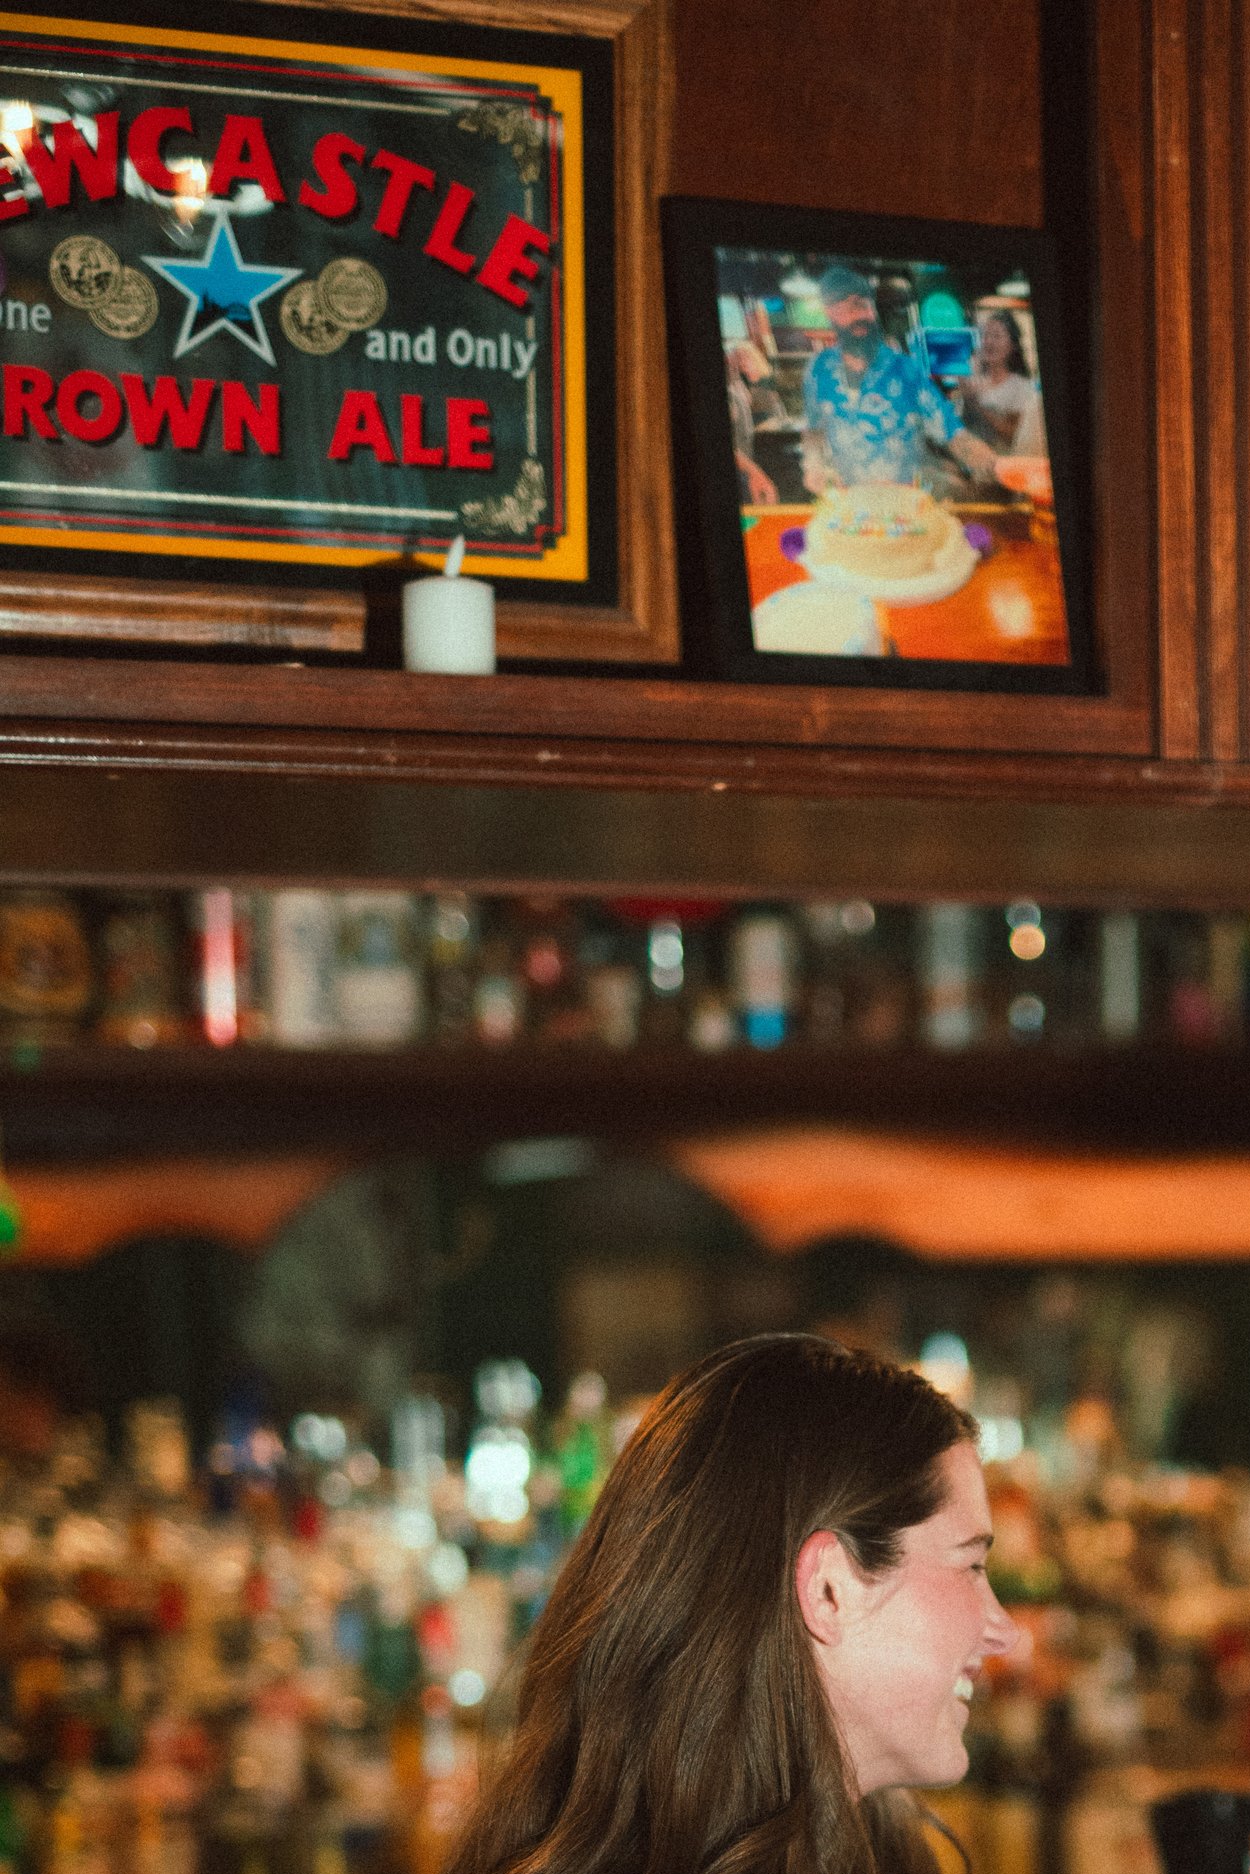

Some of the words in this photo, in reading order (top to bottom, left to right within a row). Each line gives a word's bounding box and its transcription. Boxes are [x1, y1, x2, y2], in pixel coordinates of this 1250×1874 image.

[0, 301, 51, 333] ne
[365, 325, 437, 366] and
[447, 328, 538, 380] Only
[327, 390, 494, 469] ALE
